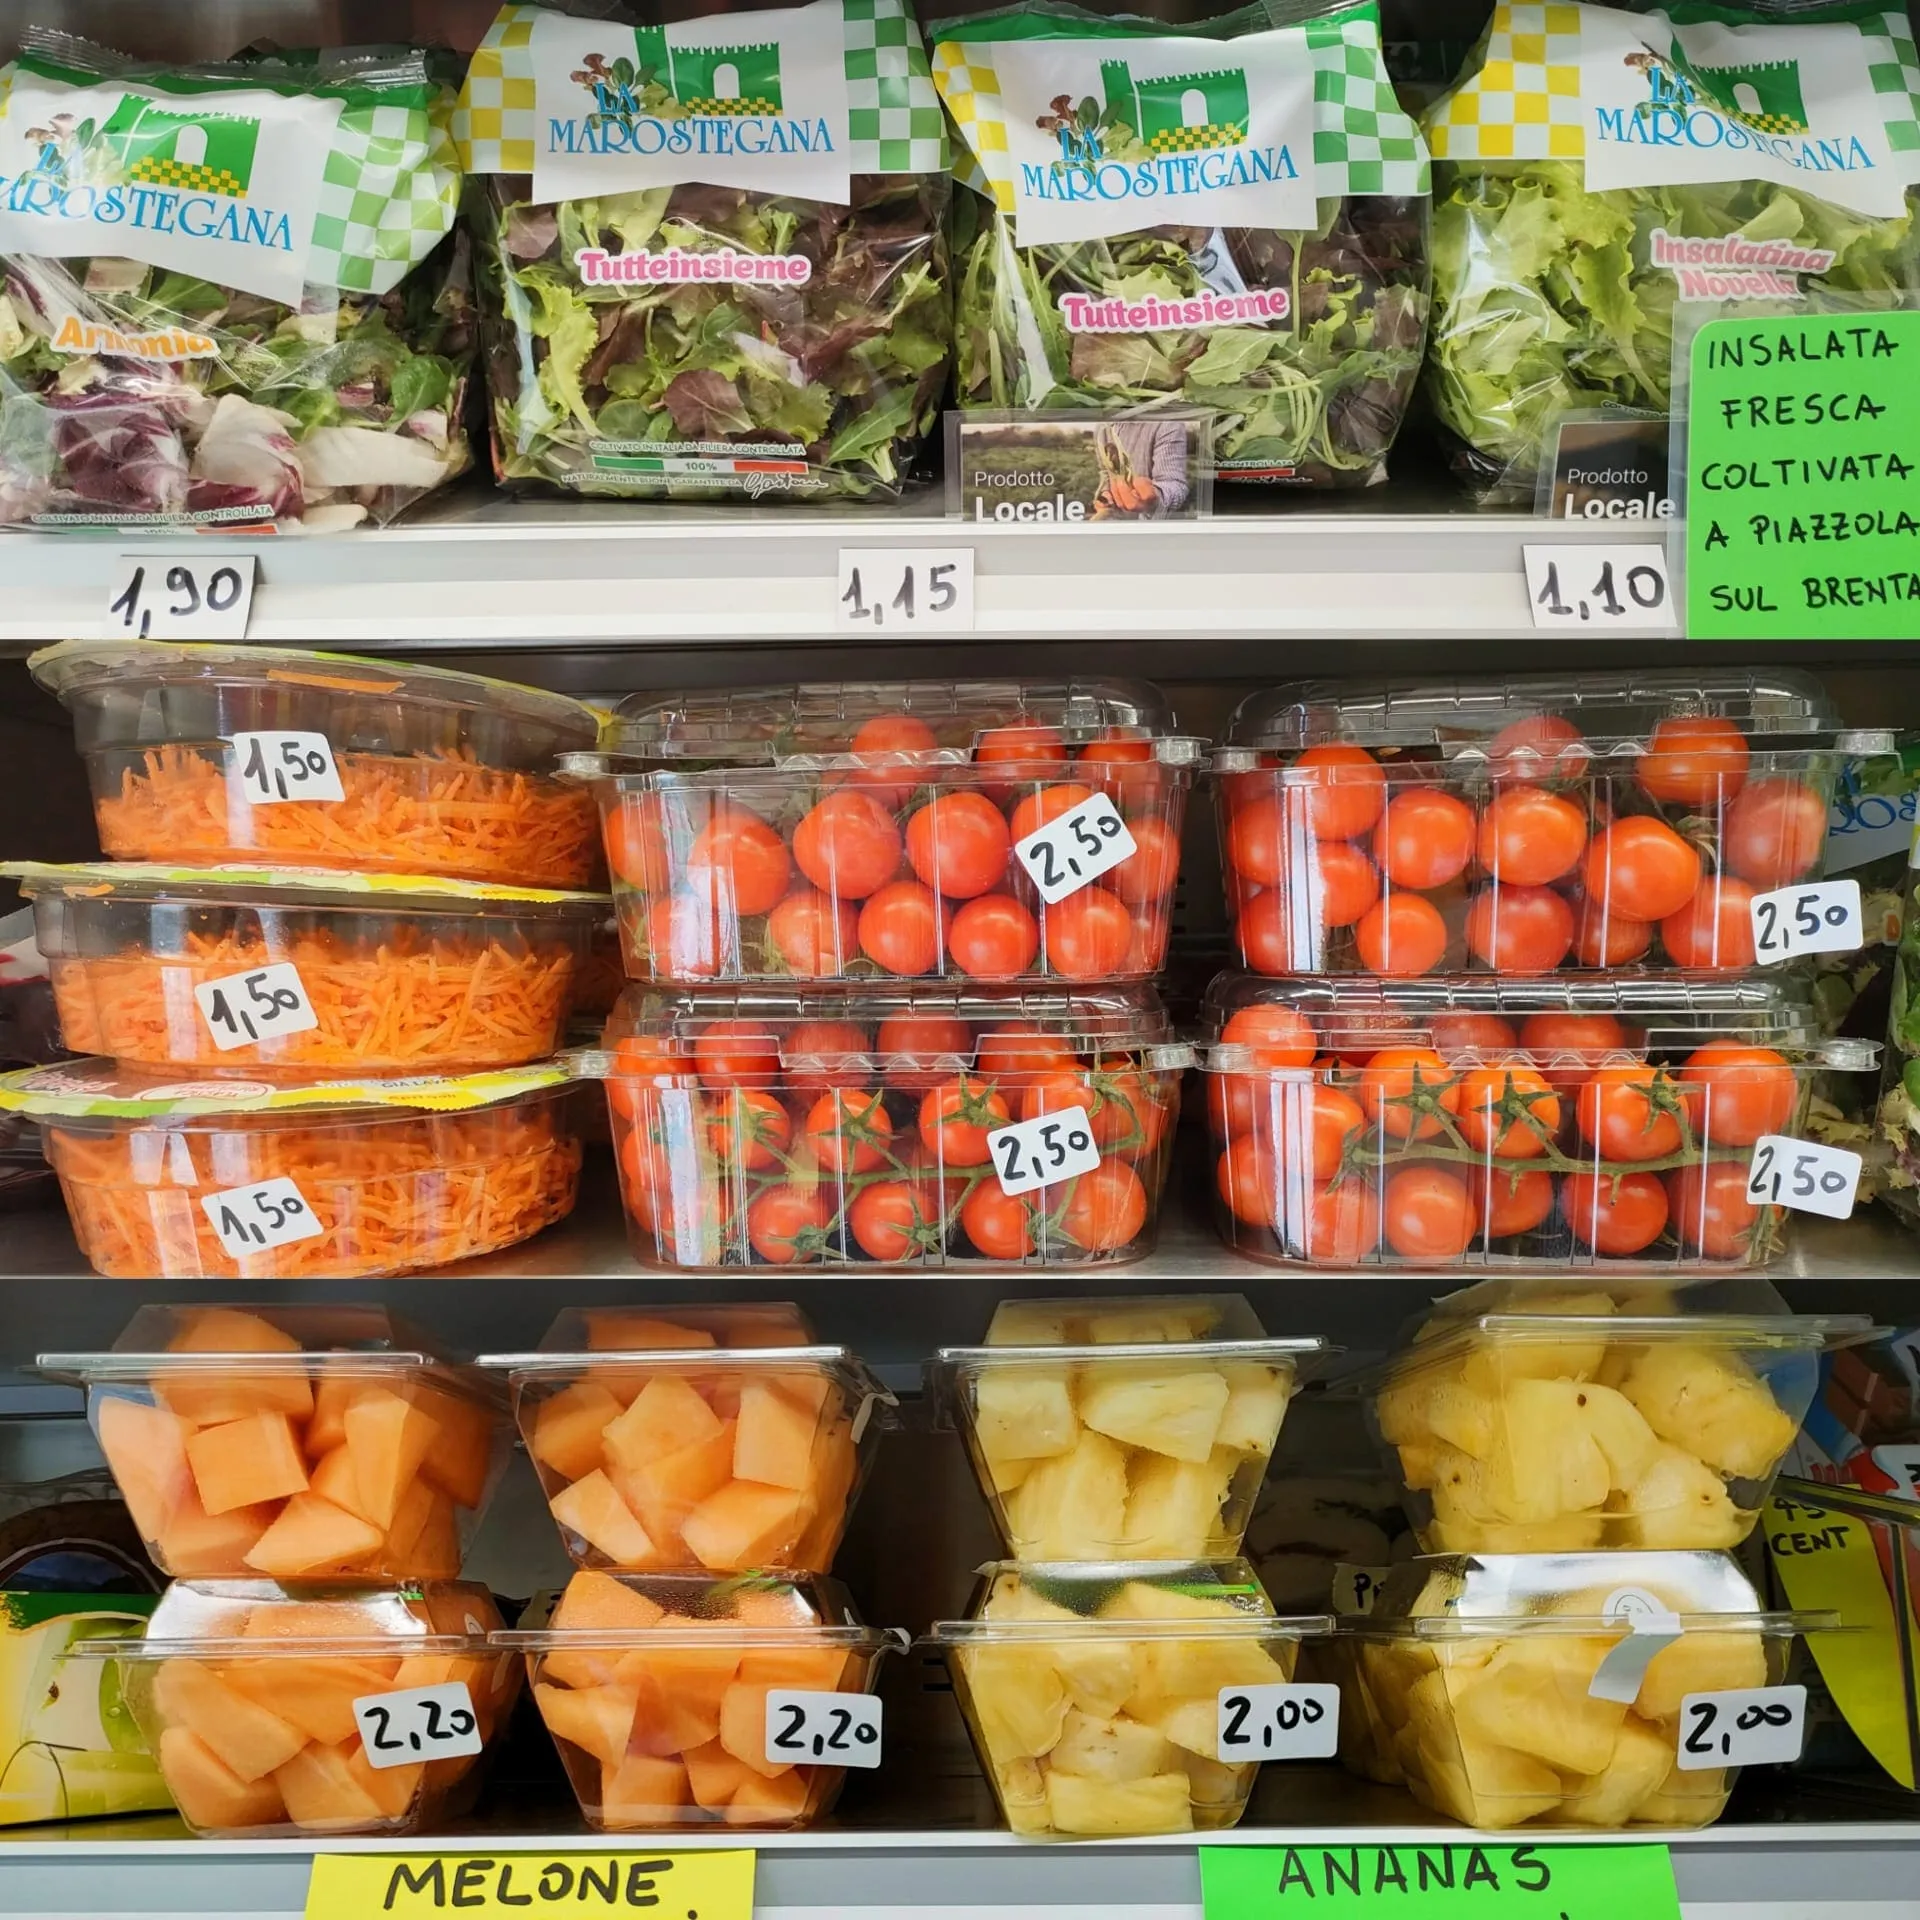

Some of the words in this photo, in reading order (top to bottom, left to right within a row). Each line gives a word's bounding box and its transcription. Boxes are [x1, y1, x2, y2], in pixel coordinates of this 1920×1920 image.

[594, 82, 639, 114] LA
[1650, 67, 1695, 104] LA
[548, 118, 835, 155] MAROSTEGANA
[1059, 126, 1103, 161] LA
[1021, 145, 1299, 200] MAROSTEGANA
[580, 251, 808, 281] Tutteinsieme
[1656, 233, 1831, 270] Insalatina
[1063, 290, 1287, 328] Tutteinsieme
[1708, 328, 1899, 369] INSALATA
[1720, 393, 1887, 429] FRESCA
[685, 462, 718, 471] 100%
[975, 470, 1054, 487] Prodotto
[1567, 468, 1648, 484] Prodotto
[1701, 453, 1915, 490] COLTIVATA
[194, 506, 273, 522] CONTROLLATA
[975, 494, 1085, 521] Locale
[1564, 491, 1677, 520] Locale
[1705, 520, 1729, 551] A
[1749, 510, 1920, 545] PIAZZOLA
[110, 566, 243, 639] 1,90
[842, 564, 957, 625] 1,15
[1537, 561, 1664, 620] 1,10
[1709, 584, 1778, 612] SUL
[1801, 572, 1920, 609] BRENTA
[244, 737, 326, 799] 1,50
[1030, 815, 1121, 887] 2,50
[1757, 894, 1848, 950] 2,50
[211, 972, 300, 1039] 1,50
[998, 1123, 1089, 1180] 2,50
[1750, 1145, 1848, 1202] 2,50
[220, 1192, 304, 1244] 1,50
[1771, 1526, 1850, 1556] CENT
[364, 1700, 475, 1751] 2,20
[774, 1704, 878, 1756] 2,20
[1223, 1695, 1324, 1748] 2,00
[1685, 1702, 1793, 1755] 2,00
[383, 1859, 673, 1910] MELONE
[1279, 1843, 1550, 1898] ANANAS
